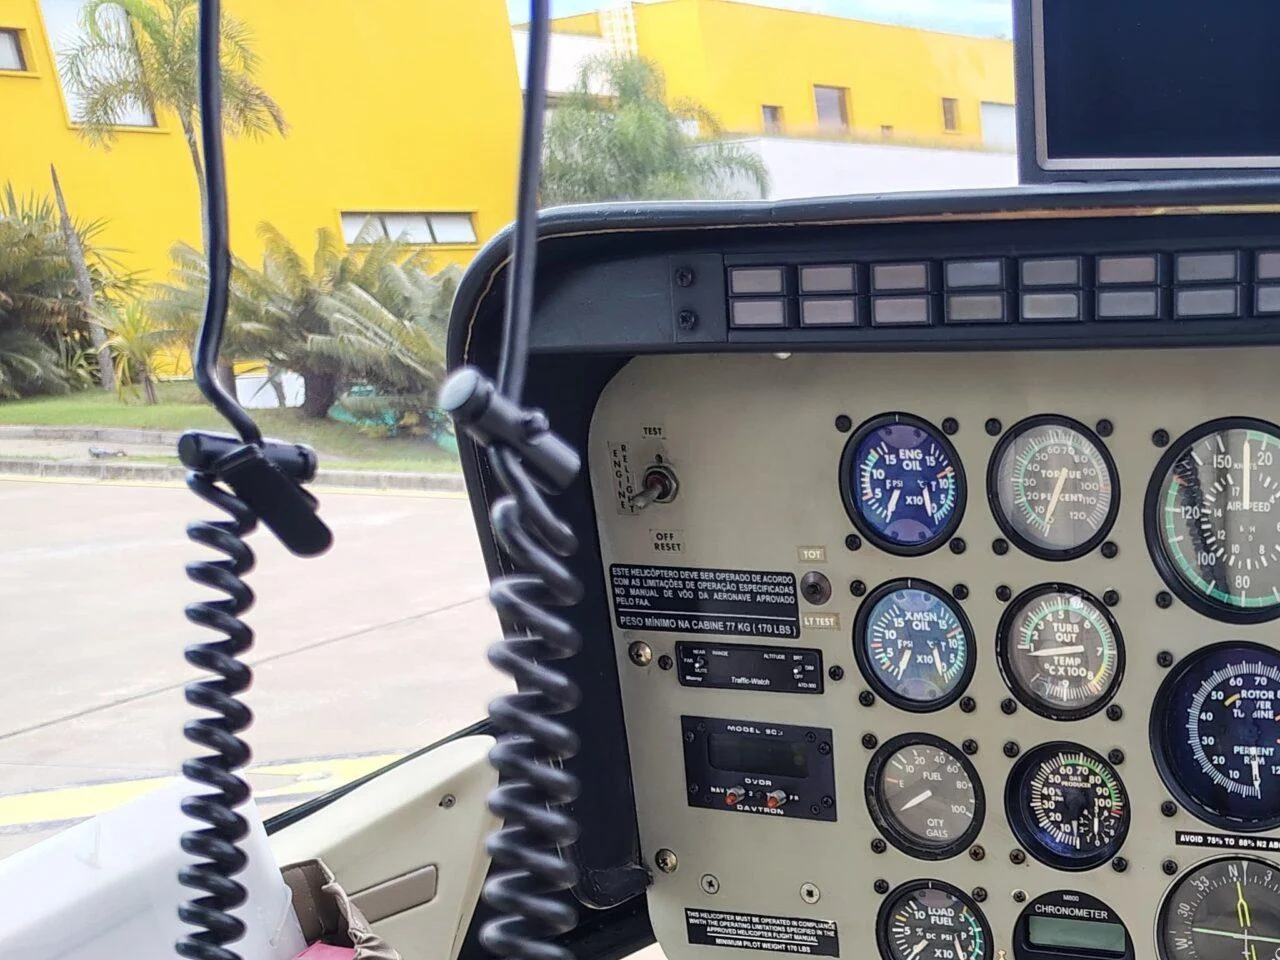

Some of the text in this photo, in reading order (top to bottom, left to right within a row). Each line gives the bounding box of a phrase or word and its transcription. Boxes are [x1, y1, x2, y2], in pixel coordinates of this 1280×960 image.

[643, 427, 662, 435] TEST
[900, 449, 923, 459] ENG
[903, 461, 921, 470] OIL
[1213, 455, 1231, 468] 150
[906, 496, 923, 504] X10
[1227, 502, 1270, 511] AIRPEED
[656, 533, 673, 541] OFF
[654, 543, 681, 551] RESET
[804, 551, 820, 559] TOT
[700, 572, 714, 580] SER
[716, 573, 750, 581] OPERADO
[739, 584, 794, 593] ESPECIFICADAS
[630, 588, 659, 597] MANUAL
[714, 593, 751, 601] AERONAVE
[756, 595, 795, 603] APROVADO
[616, 597, 634, 605] PELO
[904, 611, 937, 622] XMSN
[621, 617, 643, 625] PESO
[692, 620, 724, 630] CABINE
[738, 623, 750, 631] KG
[758, 624, 772, 632] 170
[774, 626, 791, 634] LBS
[804, 617, 834, 626] LT TEST
[912, 621, 930, 631] OIL
[1052, 623, 1079, 632] TURB
[1056, 633, 1077, 642] OUT
[916, 655, 933, 663] X10
[1053, 657, 1081, 666] TEMP
[732, 677, 770, 686] Traffic-Watch
[1254, 677, 1267, 685] 70
[1241, 690, 1274, 699] ROTOR
[923, 772, 942, 780] FUEL
[737, 804, 784, 814] DAVTRON
[927, 819, 944, 828] QTY
[926, 828, 948, 838] GALS
[928, 908, 954, 917] LOAD
[1035, 904, 1108, 919] CHRONOMETER
[931, 916, 954, 926] FUEL
[934, 949, 953, 959] X10
